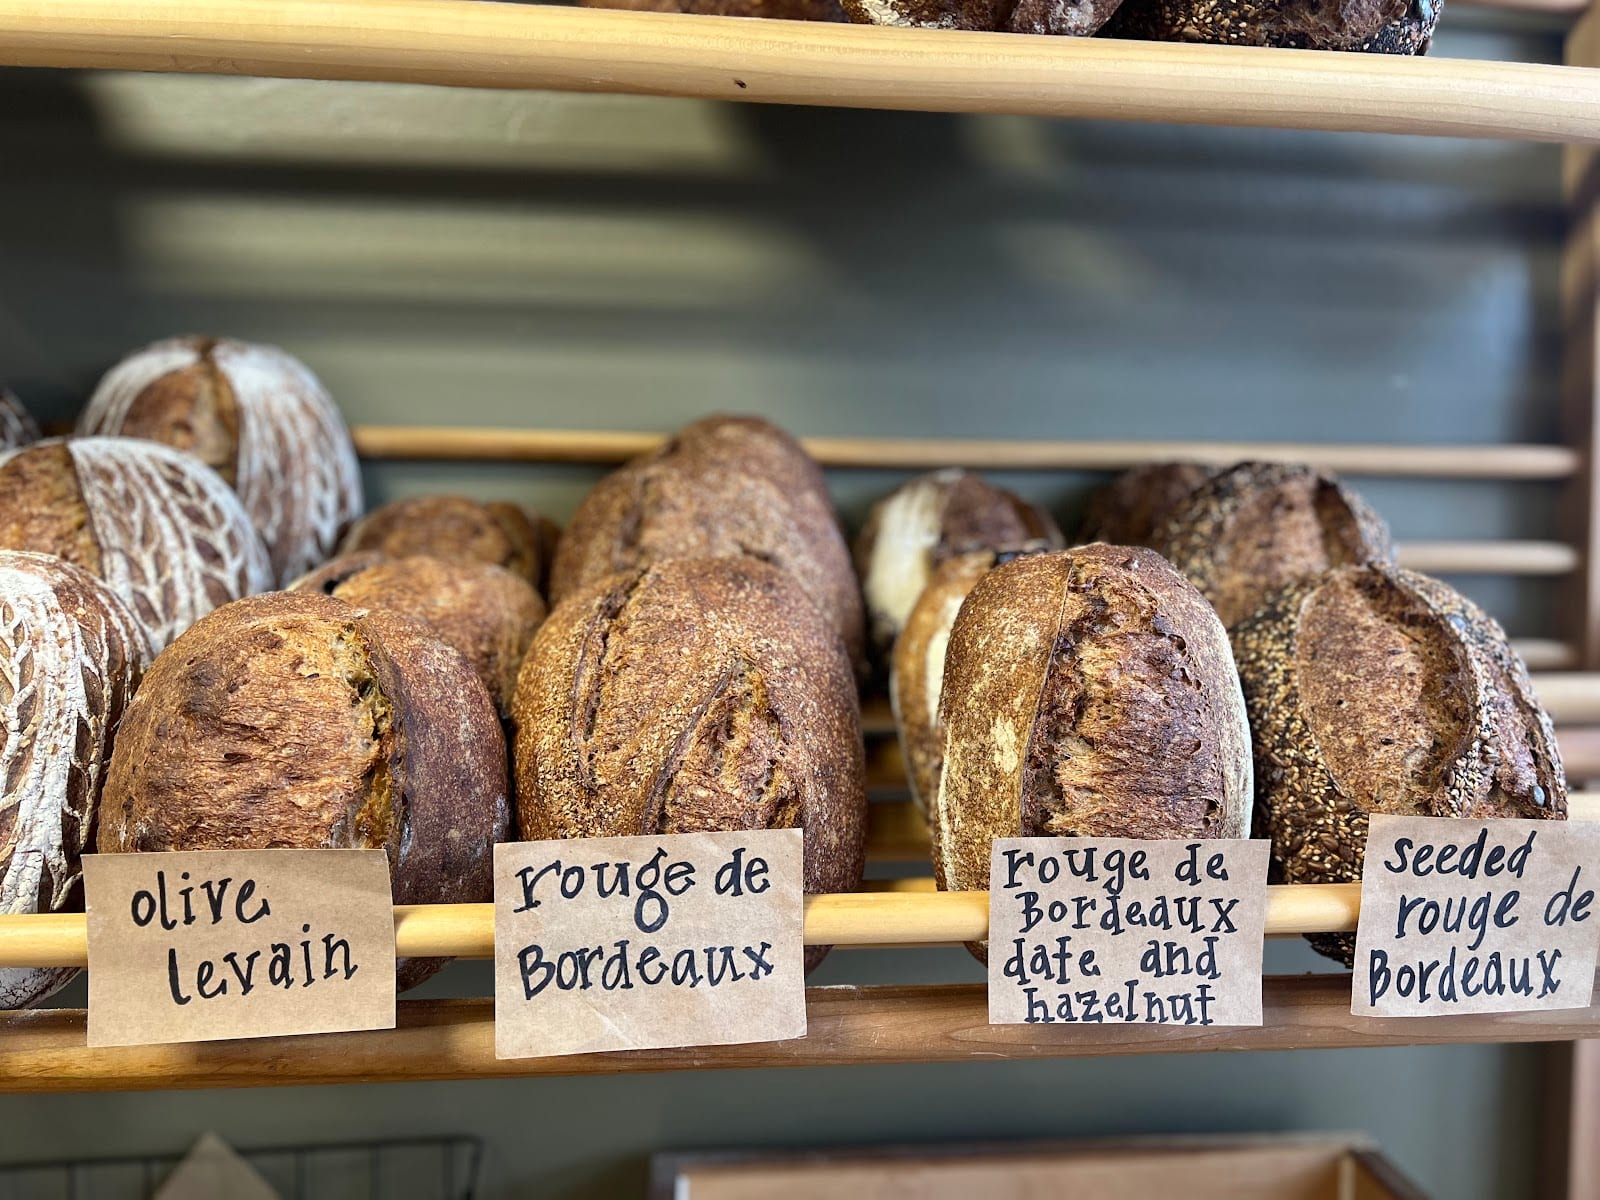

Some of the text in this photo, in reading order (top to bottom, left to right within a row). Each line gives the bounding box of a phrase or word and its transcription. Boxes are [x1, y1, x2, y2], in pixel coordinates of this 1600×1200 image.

[1002, 843, 1229, 895] rouge de
[1383, 827, 1538, 880] seeded
[131, 870, 271, 931] olive
[513, 846, 771, 934] rouge de
[1014, 891, 1240, 937] Bordeaux
[1395, 865, 1595, 951] rouge de
[168, 923, 359, 1006] levain
[516, 939, 774, 1001] Bordeaux
[1003, 936, 1222, 986] date and
[1369, 946, 1562, 1007] Bordeaux
[1023, 979, 1216, 1025] hazelnut
